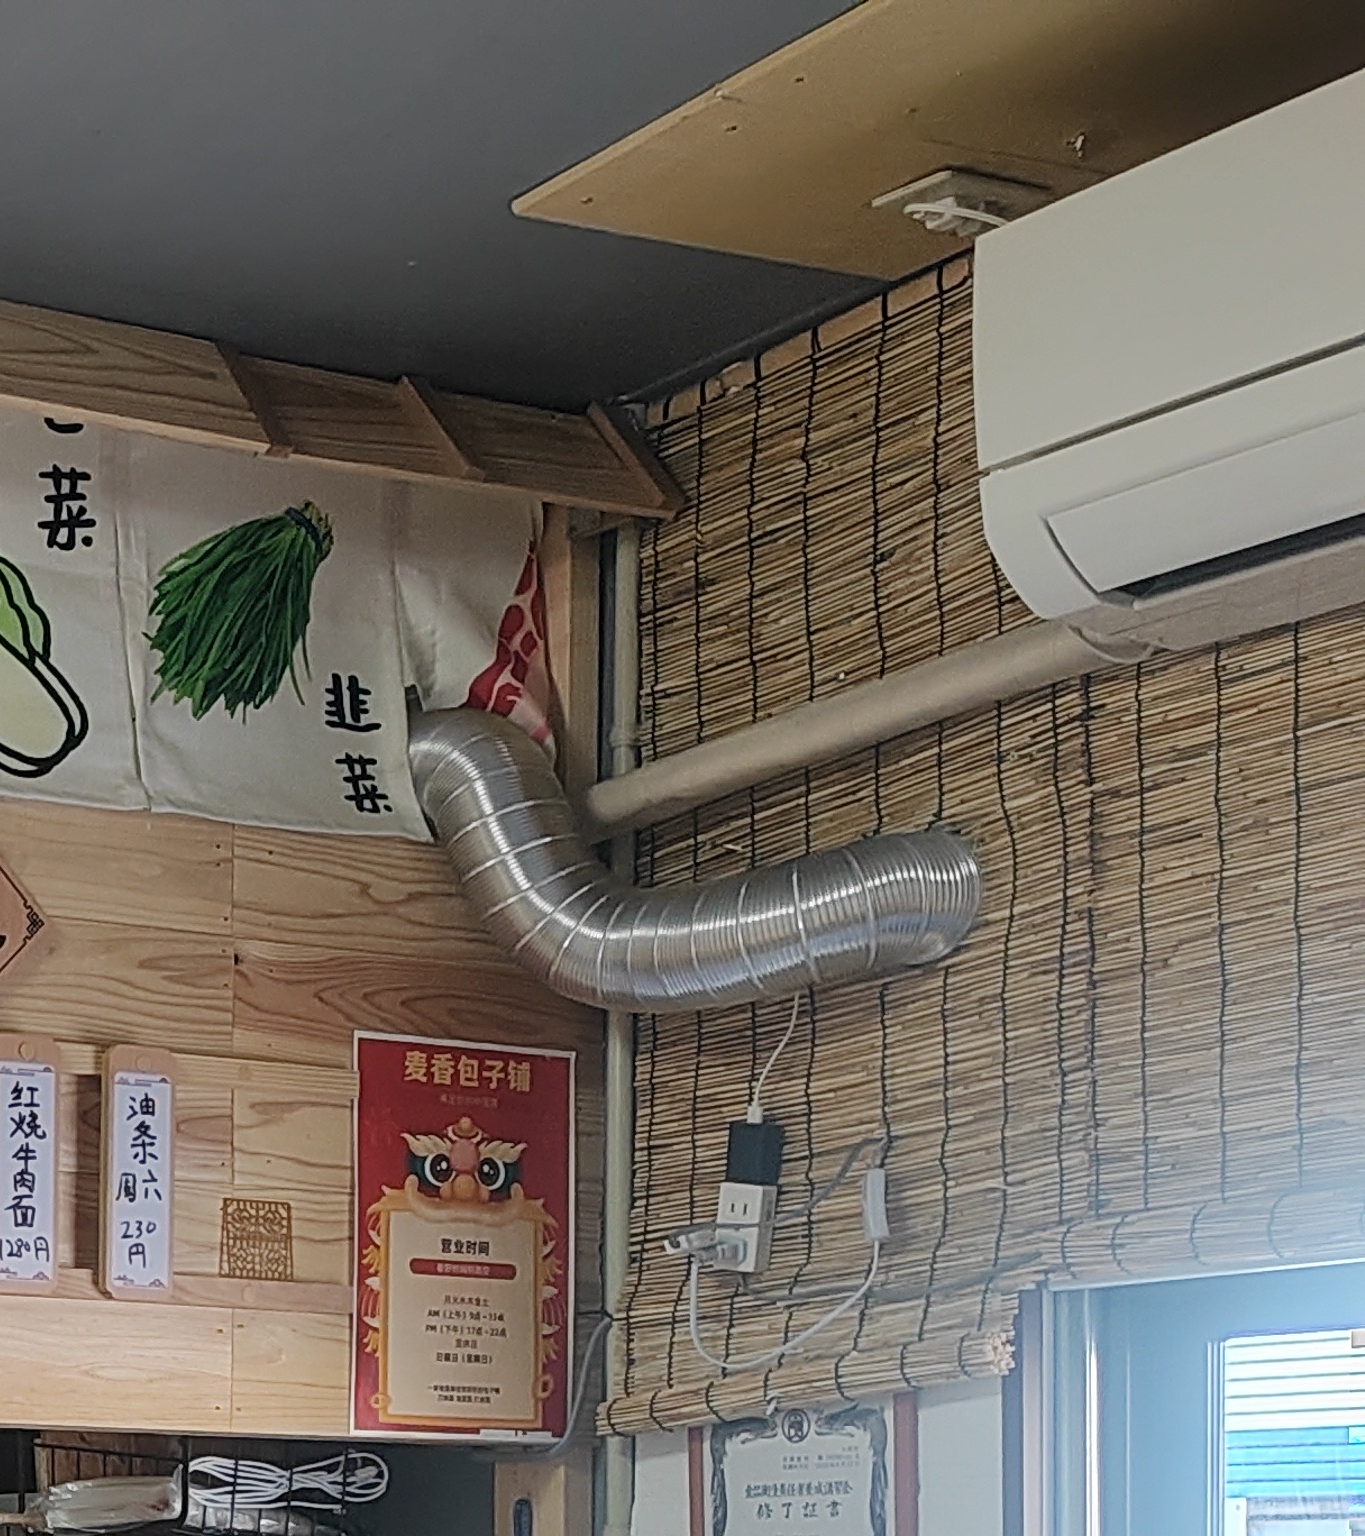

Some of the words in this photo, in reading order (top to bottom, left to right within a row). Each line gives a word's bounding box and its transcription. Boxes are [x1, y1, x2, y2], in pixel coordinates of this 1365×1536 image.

[37, 417, 95, 551] 菜
[323, 673, 393, 815] 韭菜
[404, 1050, 531, 1092] 麦香包子铺
[120, 1219, 157, 1240] 230
[0, 1236, 51, 1263] 1280円
[128, 1243, 147, 1269] 円
[440, 1238, 490, 1256] 营业时间
